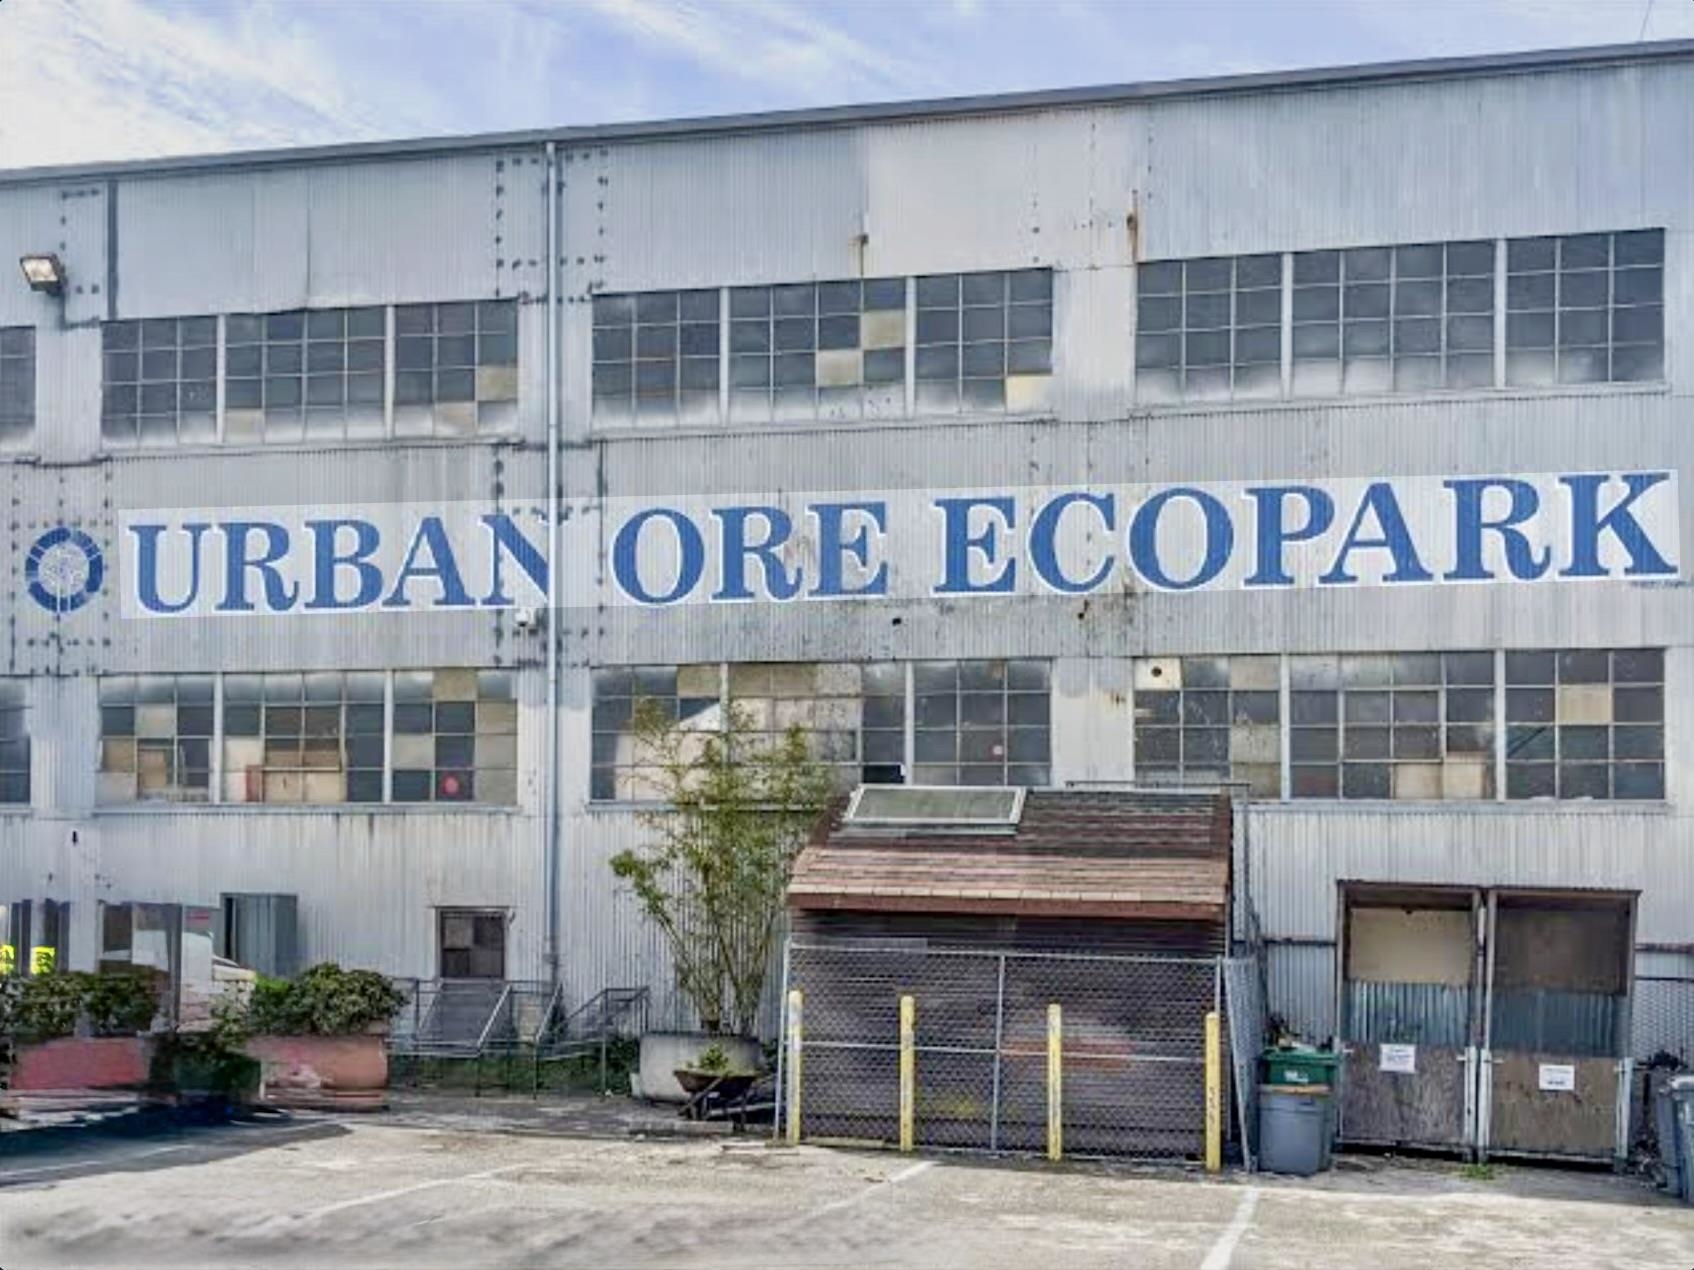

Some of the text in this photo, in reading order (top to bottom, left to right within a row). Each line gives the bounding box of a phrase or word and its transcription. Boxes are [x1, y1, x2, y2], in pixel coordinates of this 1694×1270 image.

[127, 471, 1679, 614] URBAN ORE ECOPARK
